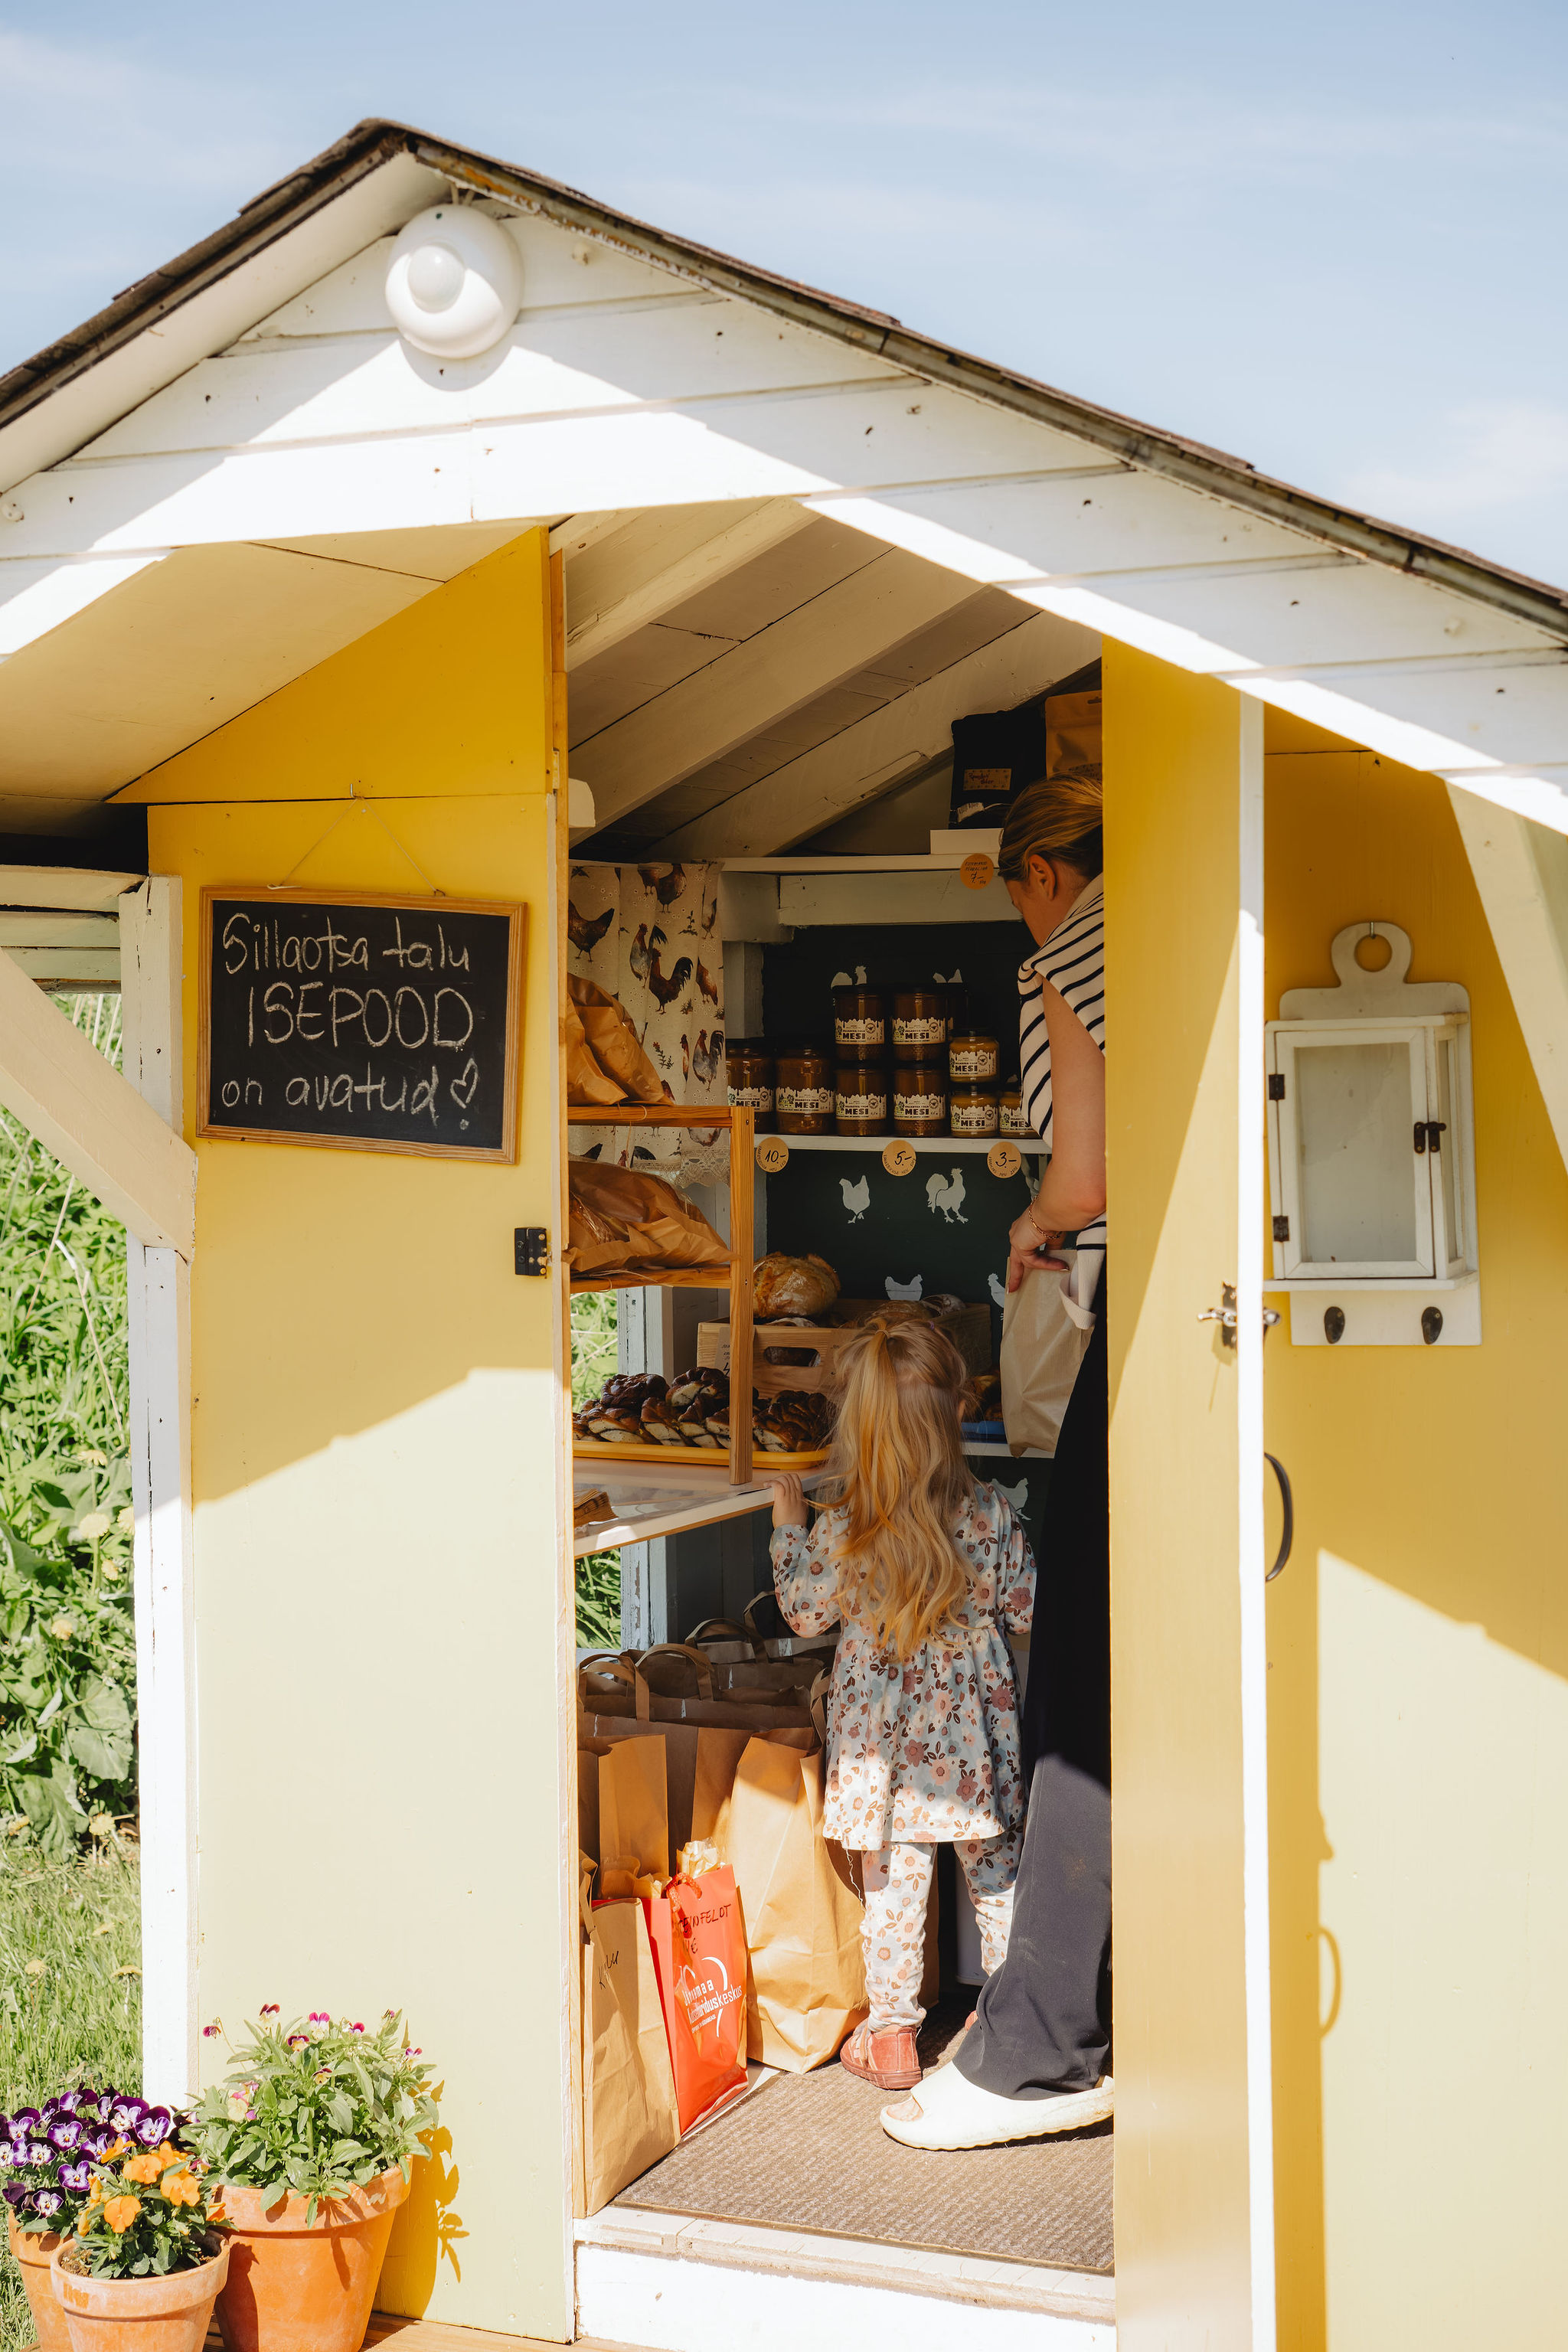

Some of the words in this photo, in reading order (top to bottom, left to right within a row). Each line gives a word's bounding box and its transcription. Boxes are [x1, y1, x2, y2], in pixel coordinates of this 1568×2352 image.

[223, 913, 368, 975] Sillaotsa
[383, 916, 470, 972] talu
[248, 982, 474, 1053] ISEPOOD
[221, 1077, 263, 1107] on
